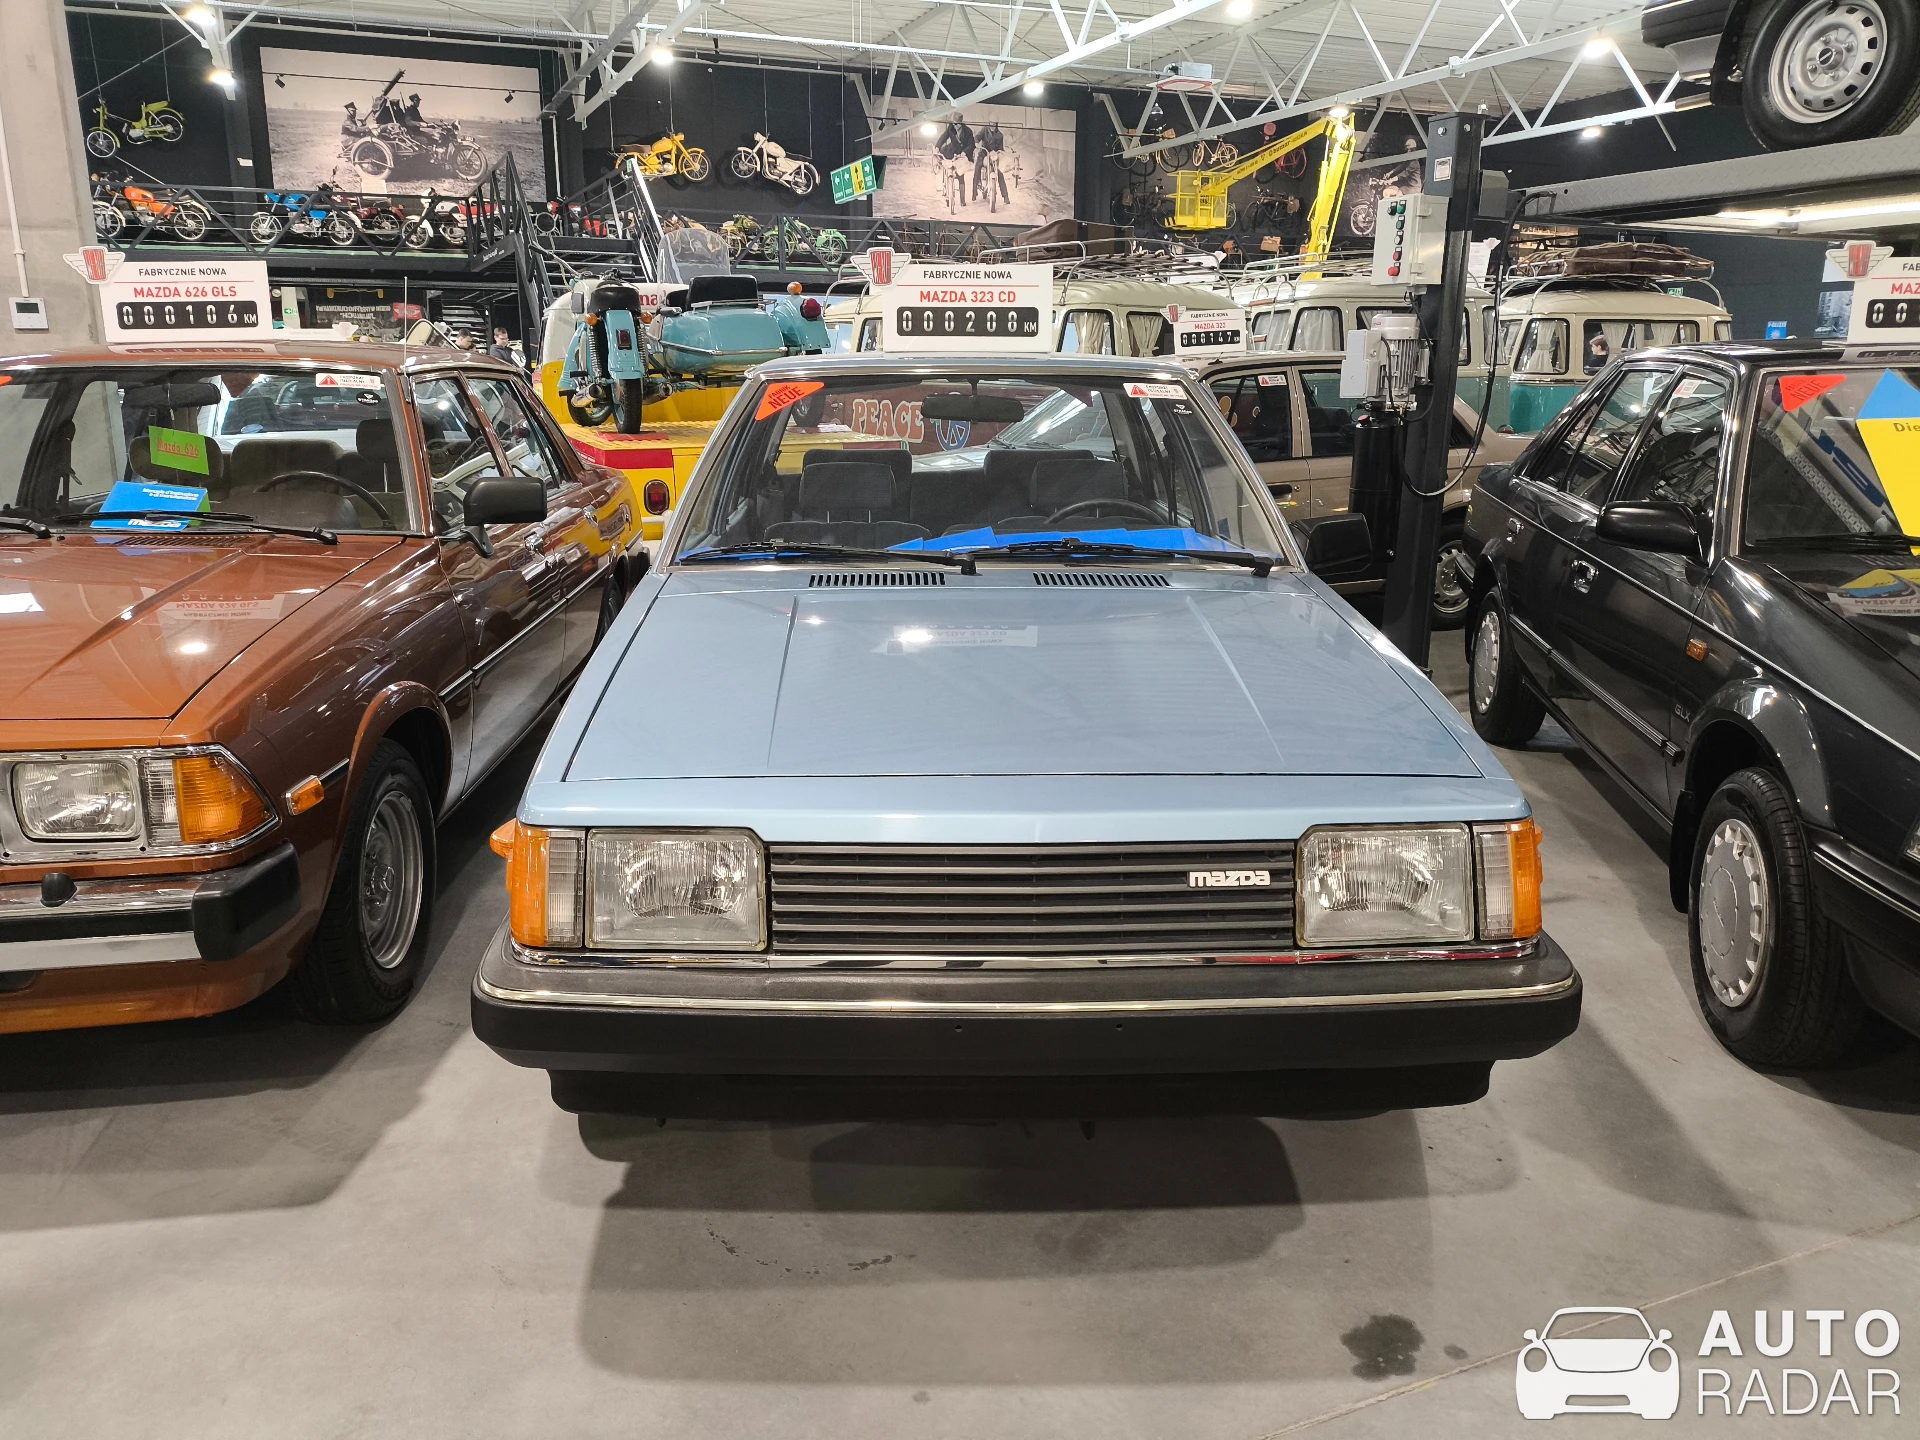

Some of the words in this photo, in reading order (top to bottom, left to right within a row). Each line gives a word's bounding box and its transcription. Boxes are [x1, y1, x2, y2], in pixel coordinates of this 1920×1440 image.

[138, 268, 196, 277] FABRYCZNIE
[199, 267, 227, 276] NOWA
[923, 270, 981, 279] FABRYCZNIE
[984, 270, 1013, 279] NOWA
[133, 286, 181, 298] MAZDA
[185, 286, 208, 298] 626
[211, 285, 237, 297] GLS
[919, 290, 967, 303] MAZDA
[971, 290, 994, 303] 323
[998, 290, 1016, 303] CD
[122, 304, 238, 326] 000106
[243, 313, 257, 325] KM
[902, 310, 1018, 333] 000208
[1024, 321, 1037, 333] KM
[1872, 302, 1920, 324] 00
[768, 386, 805, 409] NEUE
[1789, 380, 1829, 402] NEUE
[851, 398, 925, 443] PEACE
[1893, 422, 1920, 432] Die
[157, 438, 181, 453] Mazda
[184, 443, 199, 457] 626
[1674, 703, 1690, 723] GLX
[1188, 870, 1271, 887] mazda
